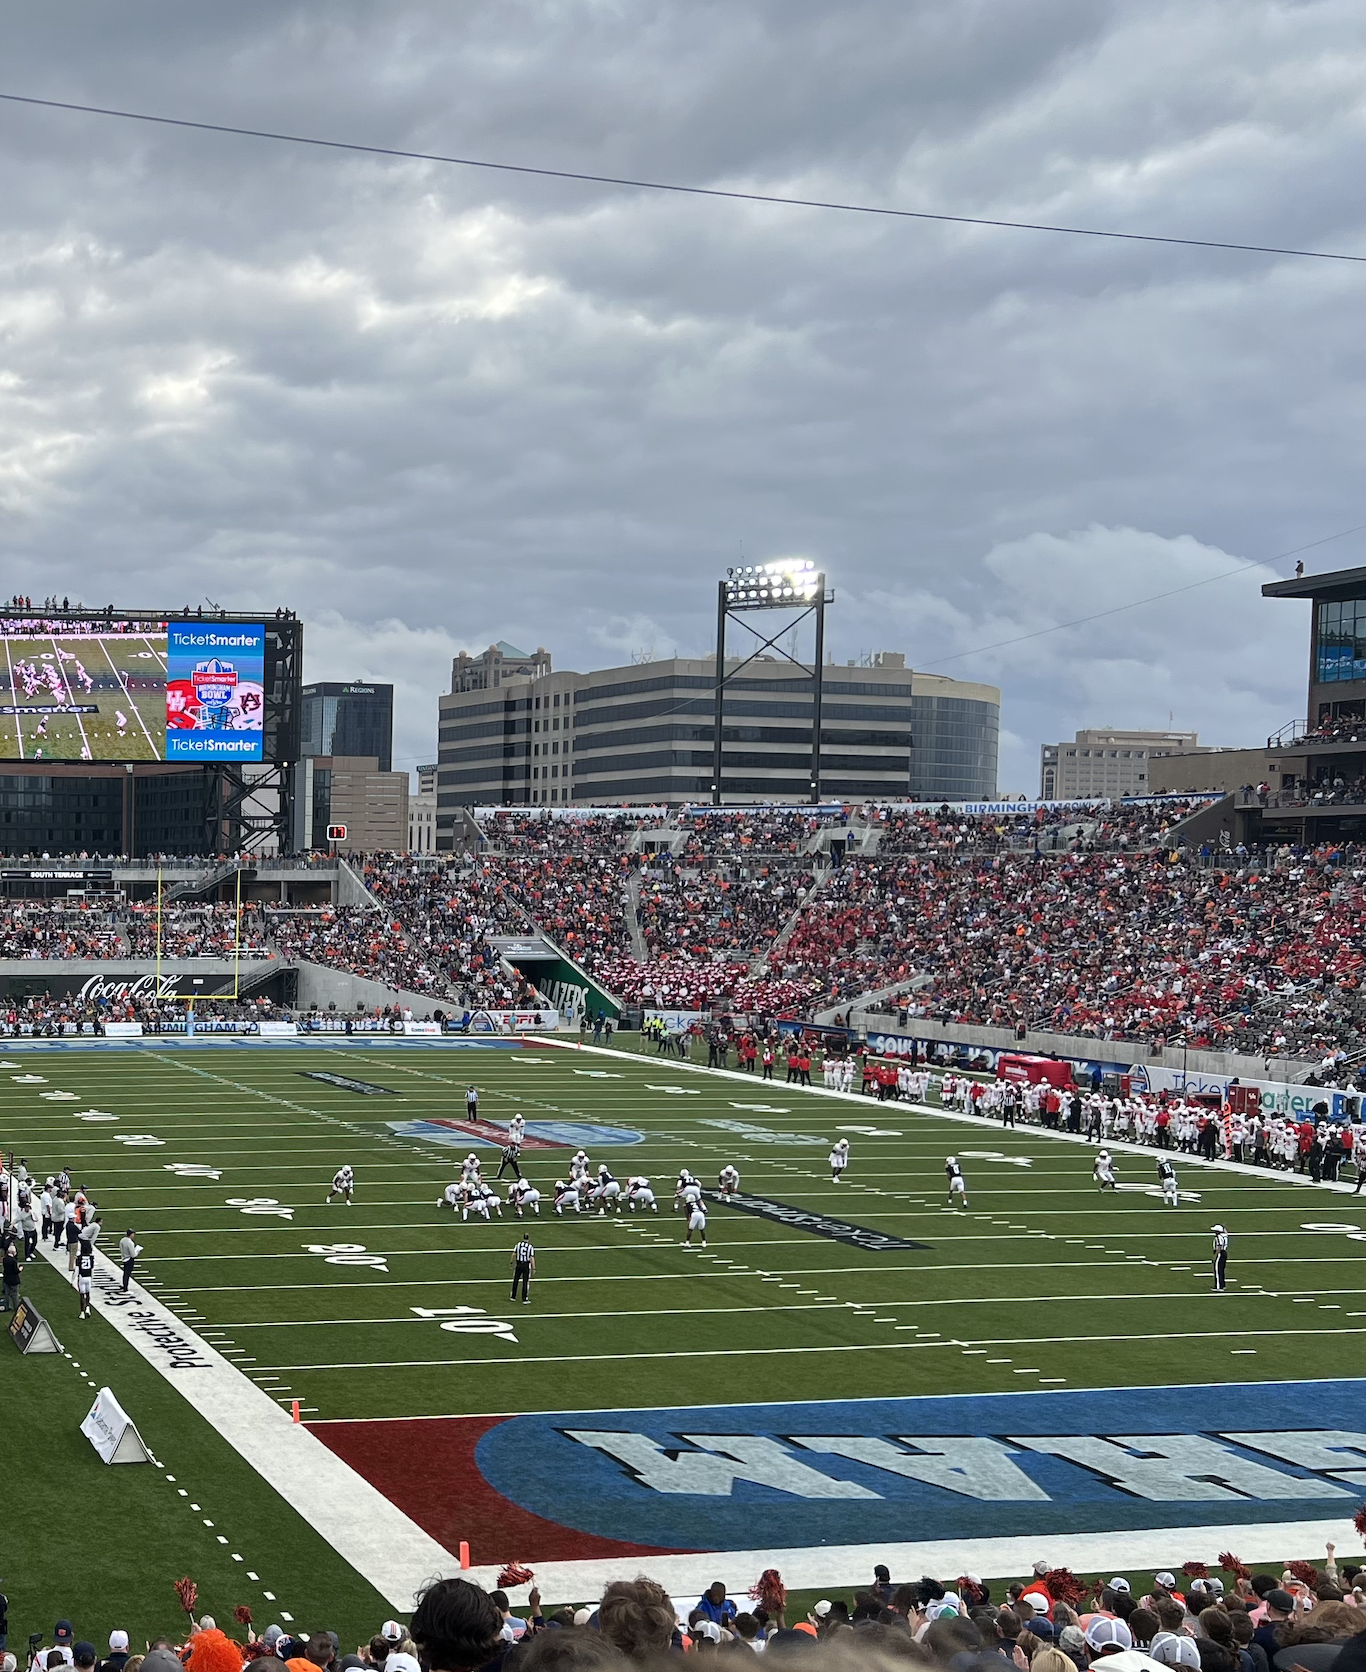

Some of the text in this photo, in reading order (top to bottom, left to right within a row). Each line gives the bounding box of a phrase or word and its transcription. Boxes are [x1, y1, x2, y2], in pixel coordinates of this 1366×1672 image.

[172, 632, 258, 646] TicketSmarter
[193, 675, 237, 683] TicketSmarter
[200, 691, 228, 700] BOWL
[171, 738, 257, 752] TicketSmarter
[333, 827, 345, 838] 17
[30, 871, 84, 879] SOUTH TERRACE
[224, 1198, 295, 1214] 30
[300, 1244, 388, 1266] 20
[81, 1258, 91, 1270] 21
[409, 1305, 515, 1334] 10
[126, 1311, 214, 1369] Protective
